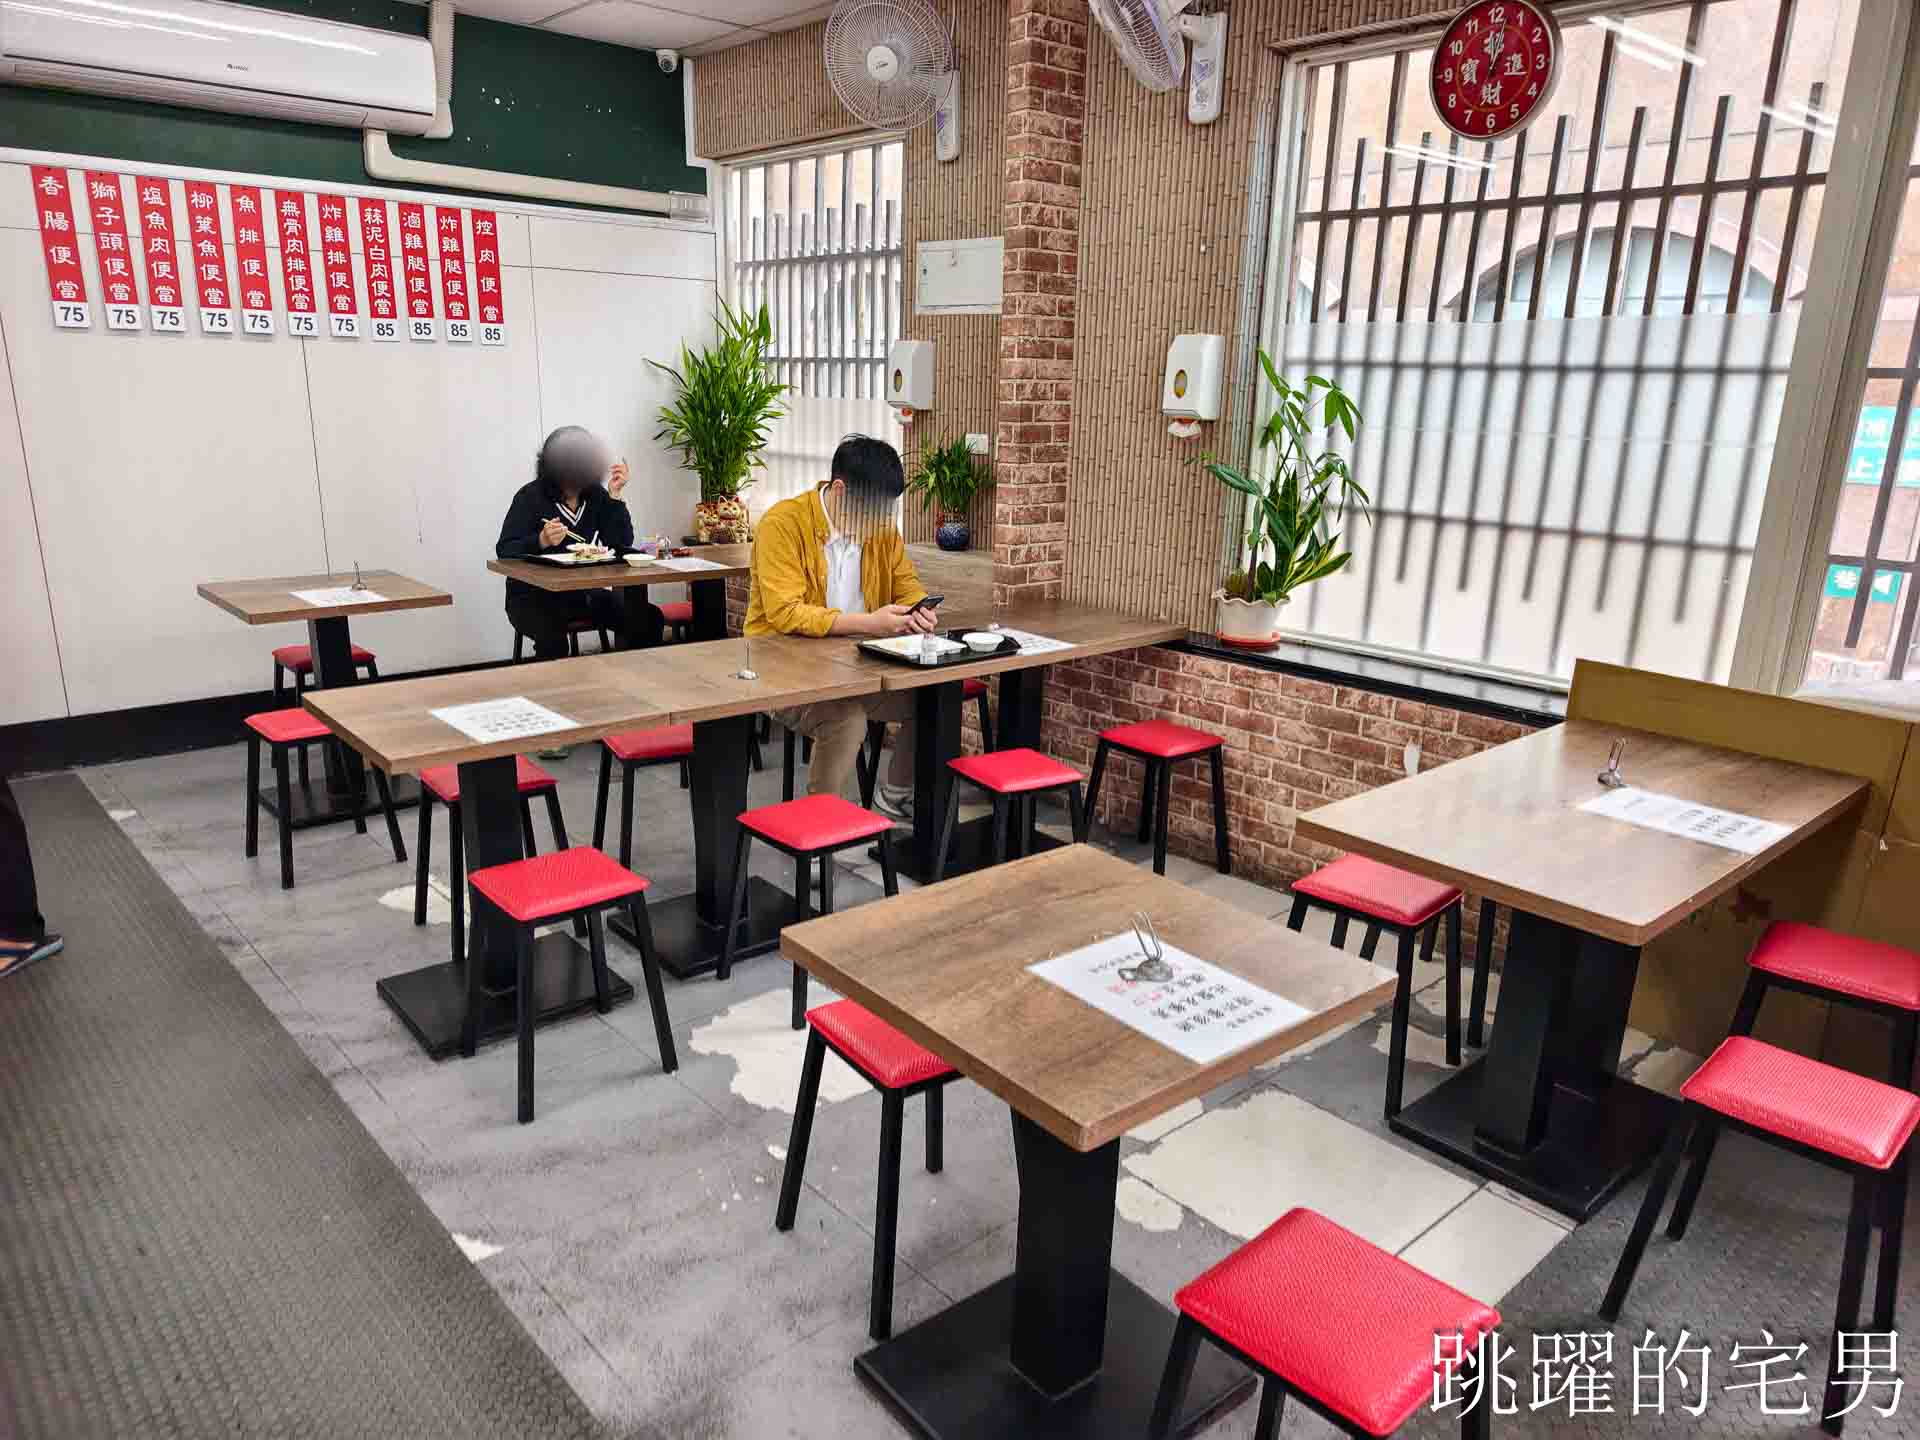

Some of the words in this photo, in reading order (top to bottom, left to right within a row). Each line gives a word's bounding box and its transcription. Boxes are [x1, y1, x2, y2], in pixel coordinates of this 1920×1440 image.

[1487, 7, 1505, 24] 12
[1517, 11, 1525, 26] 1
[1465, 19, 1479, 35] 11
[1532, 28, 1542, 43] 2
[1448, 39, 1463, 56] 10
[1535, 54, 1545, 70] 3
[1443, 68, 1453, 84] 9
[1527, 82, 1538, 97] 4
[1448, 93, 1457, 108] 8
[1463, 110, 1473, 125] 7
[1510, 103, 1520, 119] 5
[1486, 113, 1496, 129] 6
[38, 175, 80, 299] 香腸便當
[90, 180, 132, 302] 獅子頭便當
[190, 190, 225, 306] 柳葉魚便當
[235, 194, 266, 308] 魚排便當
[280, 199, 311, 311] 無骨肉排便當
[321, 203, 351, 312] 炸雞排便當
[363, 207, 391, 316] 蒜泥白肉便當
[402, 211, 430, 316] 滷雞腿便當
[440, 215, 466, 318] 炸雞腿便當
[475, 219, 499, 322] 控肉便當
[59, 306, 85, 323] 75
[111, 308, 137, 325] 75
[156, 310, 180, 326] 75
[206, 312, 228, 328] 75
[247, 313, 272, 330] 75
[293, 316, 314, 332] 75
[335, 318, 355, 333] 75
[376, 323, 395, 337] 85
[414, 322, 433, 336] 85
[450, 323, 468, 337] 85
[484, 326, 501, 341] 85
